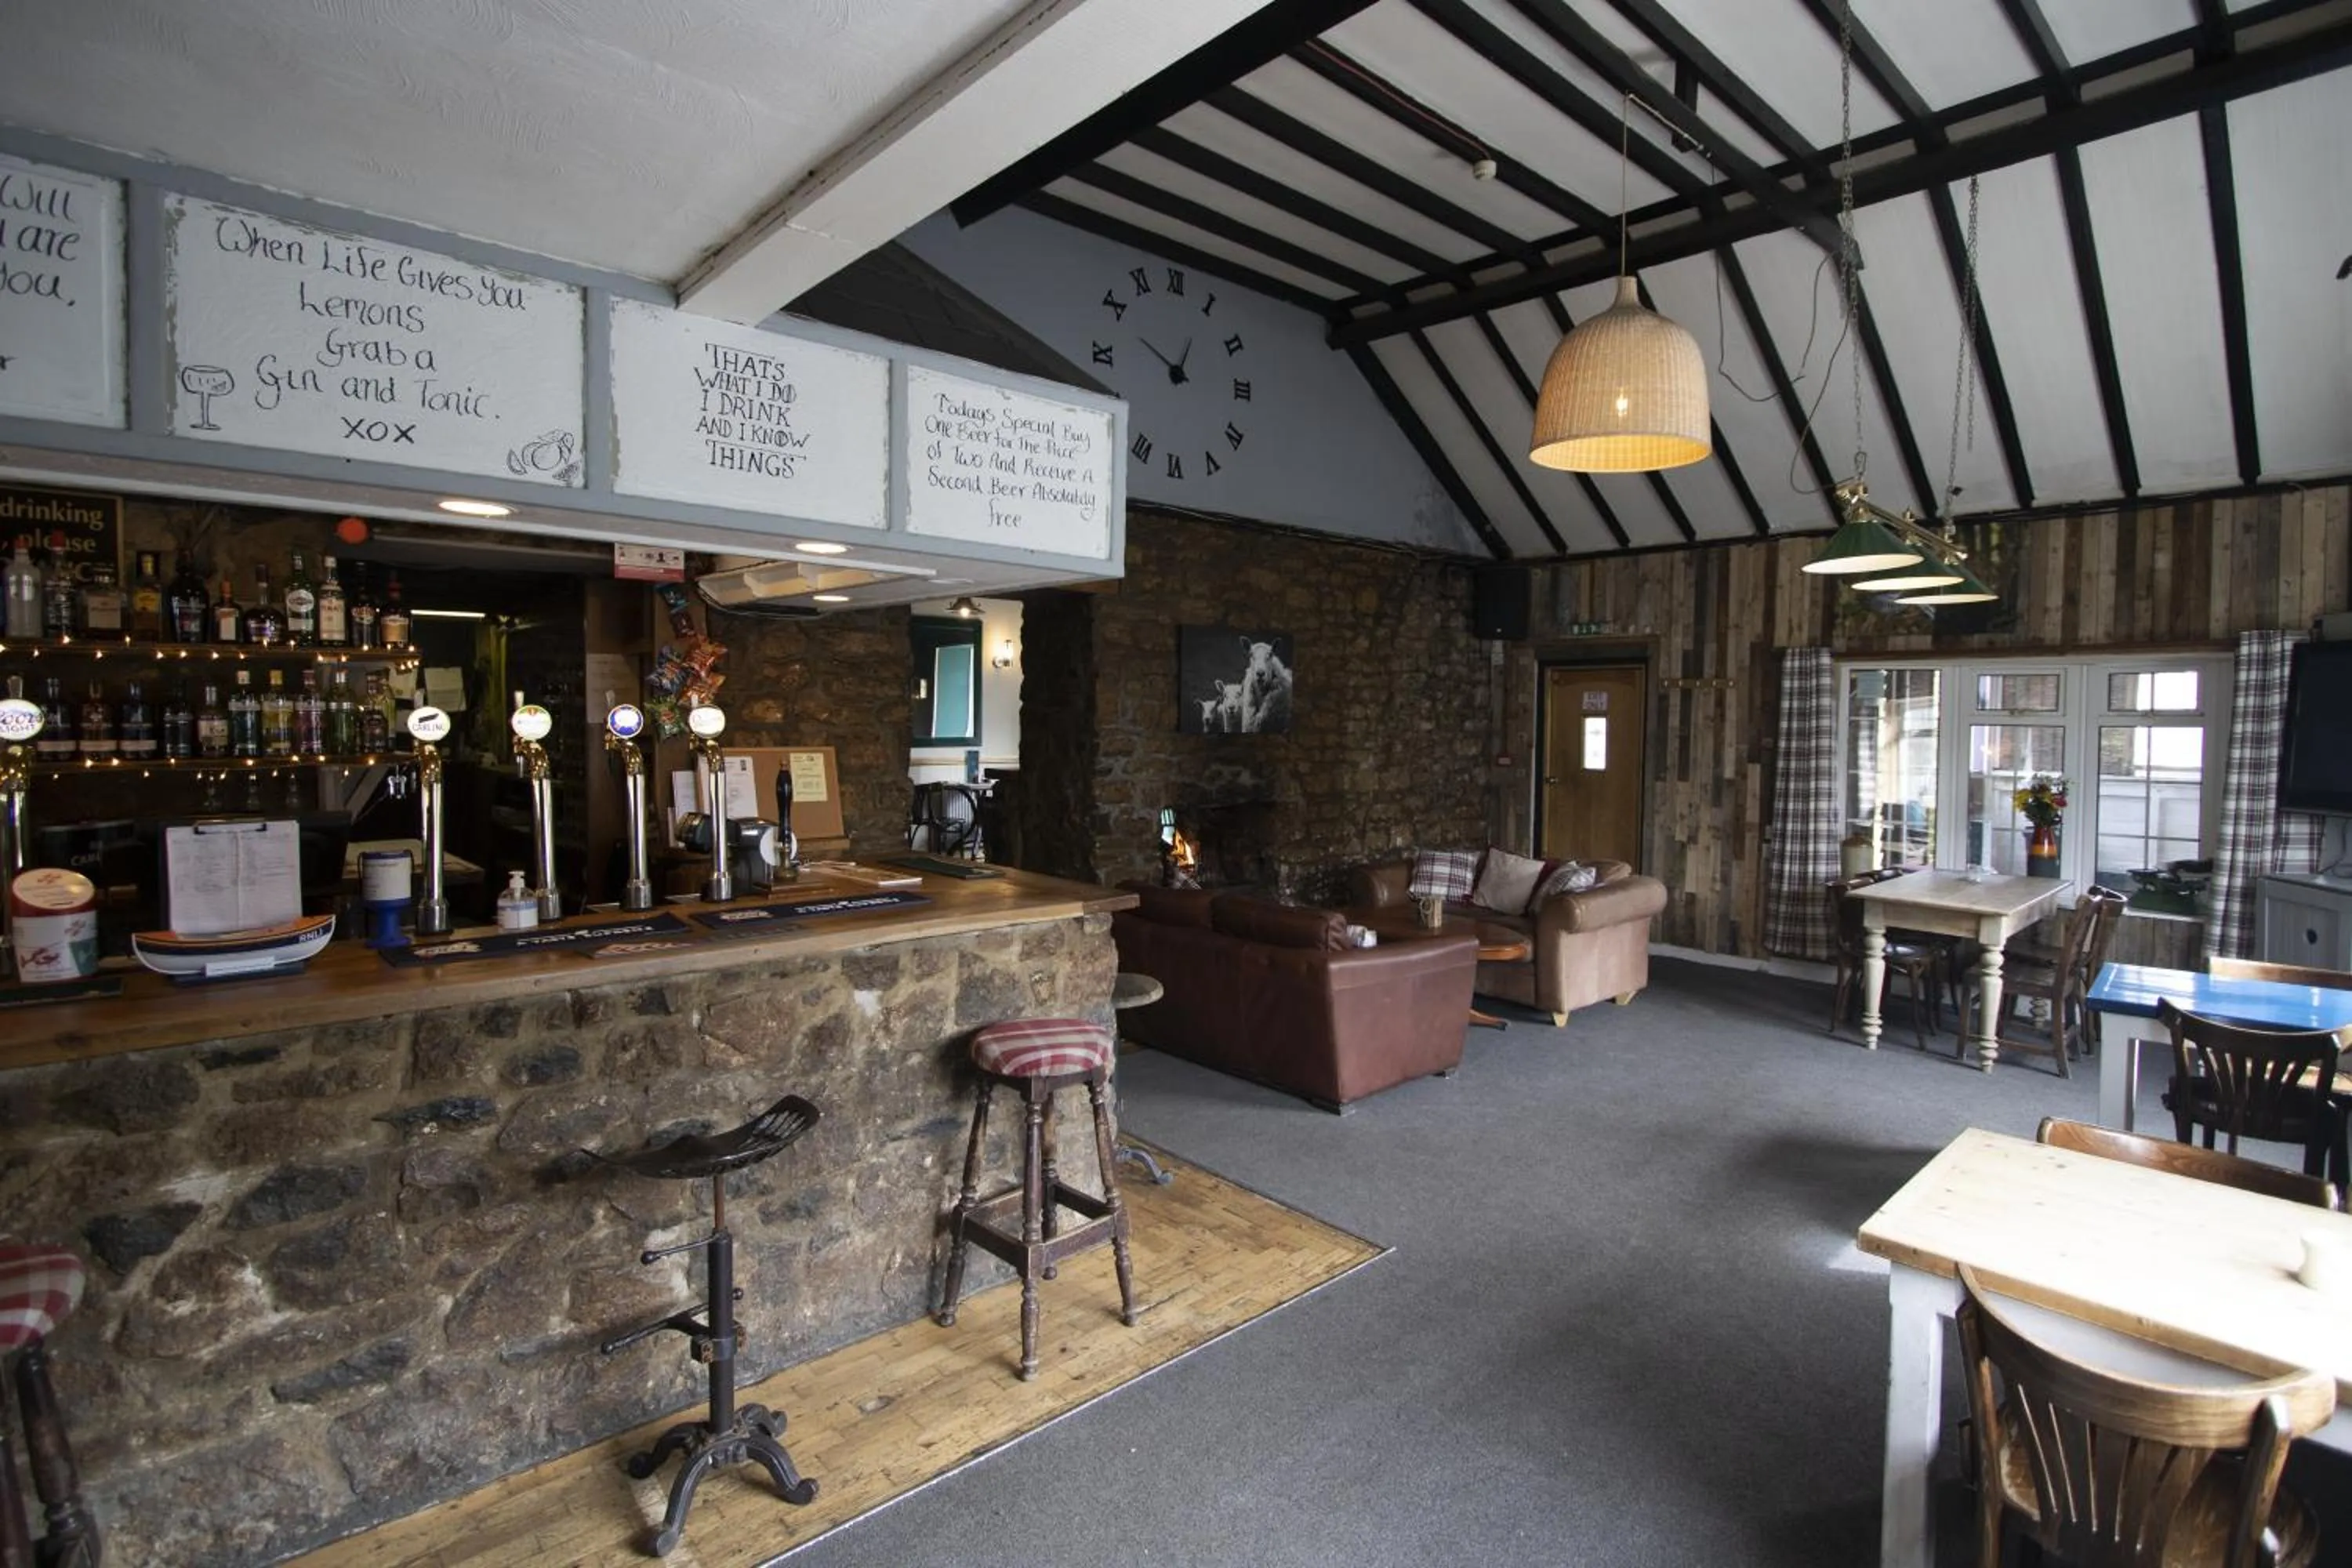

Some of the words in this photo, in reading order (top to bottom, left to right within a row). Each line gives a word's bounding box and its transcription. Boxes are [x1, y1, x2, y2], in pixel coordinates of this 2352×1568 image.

[17, 224, 80, 261] are
[216, 216, 306, 265] When
[322, 241, 389, 281] Life
[397, 255, 474, 300] Gives
[477, 275, 526, 310] You
[1129, 267, 1152, 297] XI
[1167, 267, 1185, 296] XII
[299, 281, 425, 333] Lemons
[1102, 289, 1127, 321] X
[316, 328, 407, 368] Grab
[416, 350, 437, 372] a
[705, 342, 786, 382] THATS
[255, 354, 323, 410] Gin
[341, 376, 397, 404] and
[414, 379, 500, 419] Tonic.
[692, 365, 751, 395] WHAT
[755, 380, 762, 397] I
[700, 388, 709, 412] I
[717, 392, 791, 427] DRINK
[934, 393, 996, 428] Todays
[695, 415, 733, 438] AND
[739, 422, 746, 441] I
[750, 424, 811, 448] KNOW
[924, 414, 953, 438] One
[705, 438, 807, 479] THINGS
[953, 445, 983, 469] Two
[989, 451, 1016, 475] And
[1024, 458, 1076, 481] Receive
[927, 465, 982, 495] Second
[991, 476, 1025, 498] Beer
[0, 496, 104, 531] drinking
